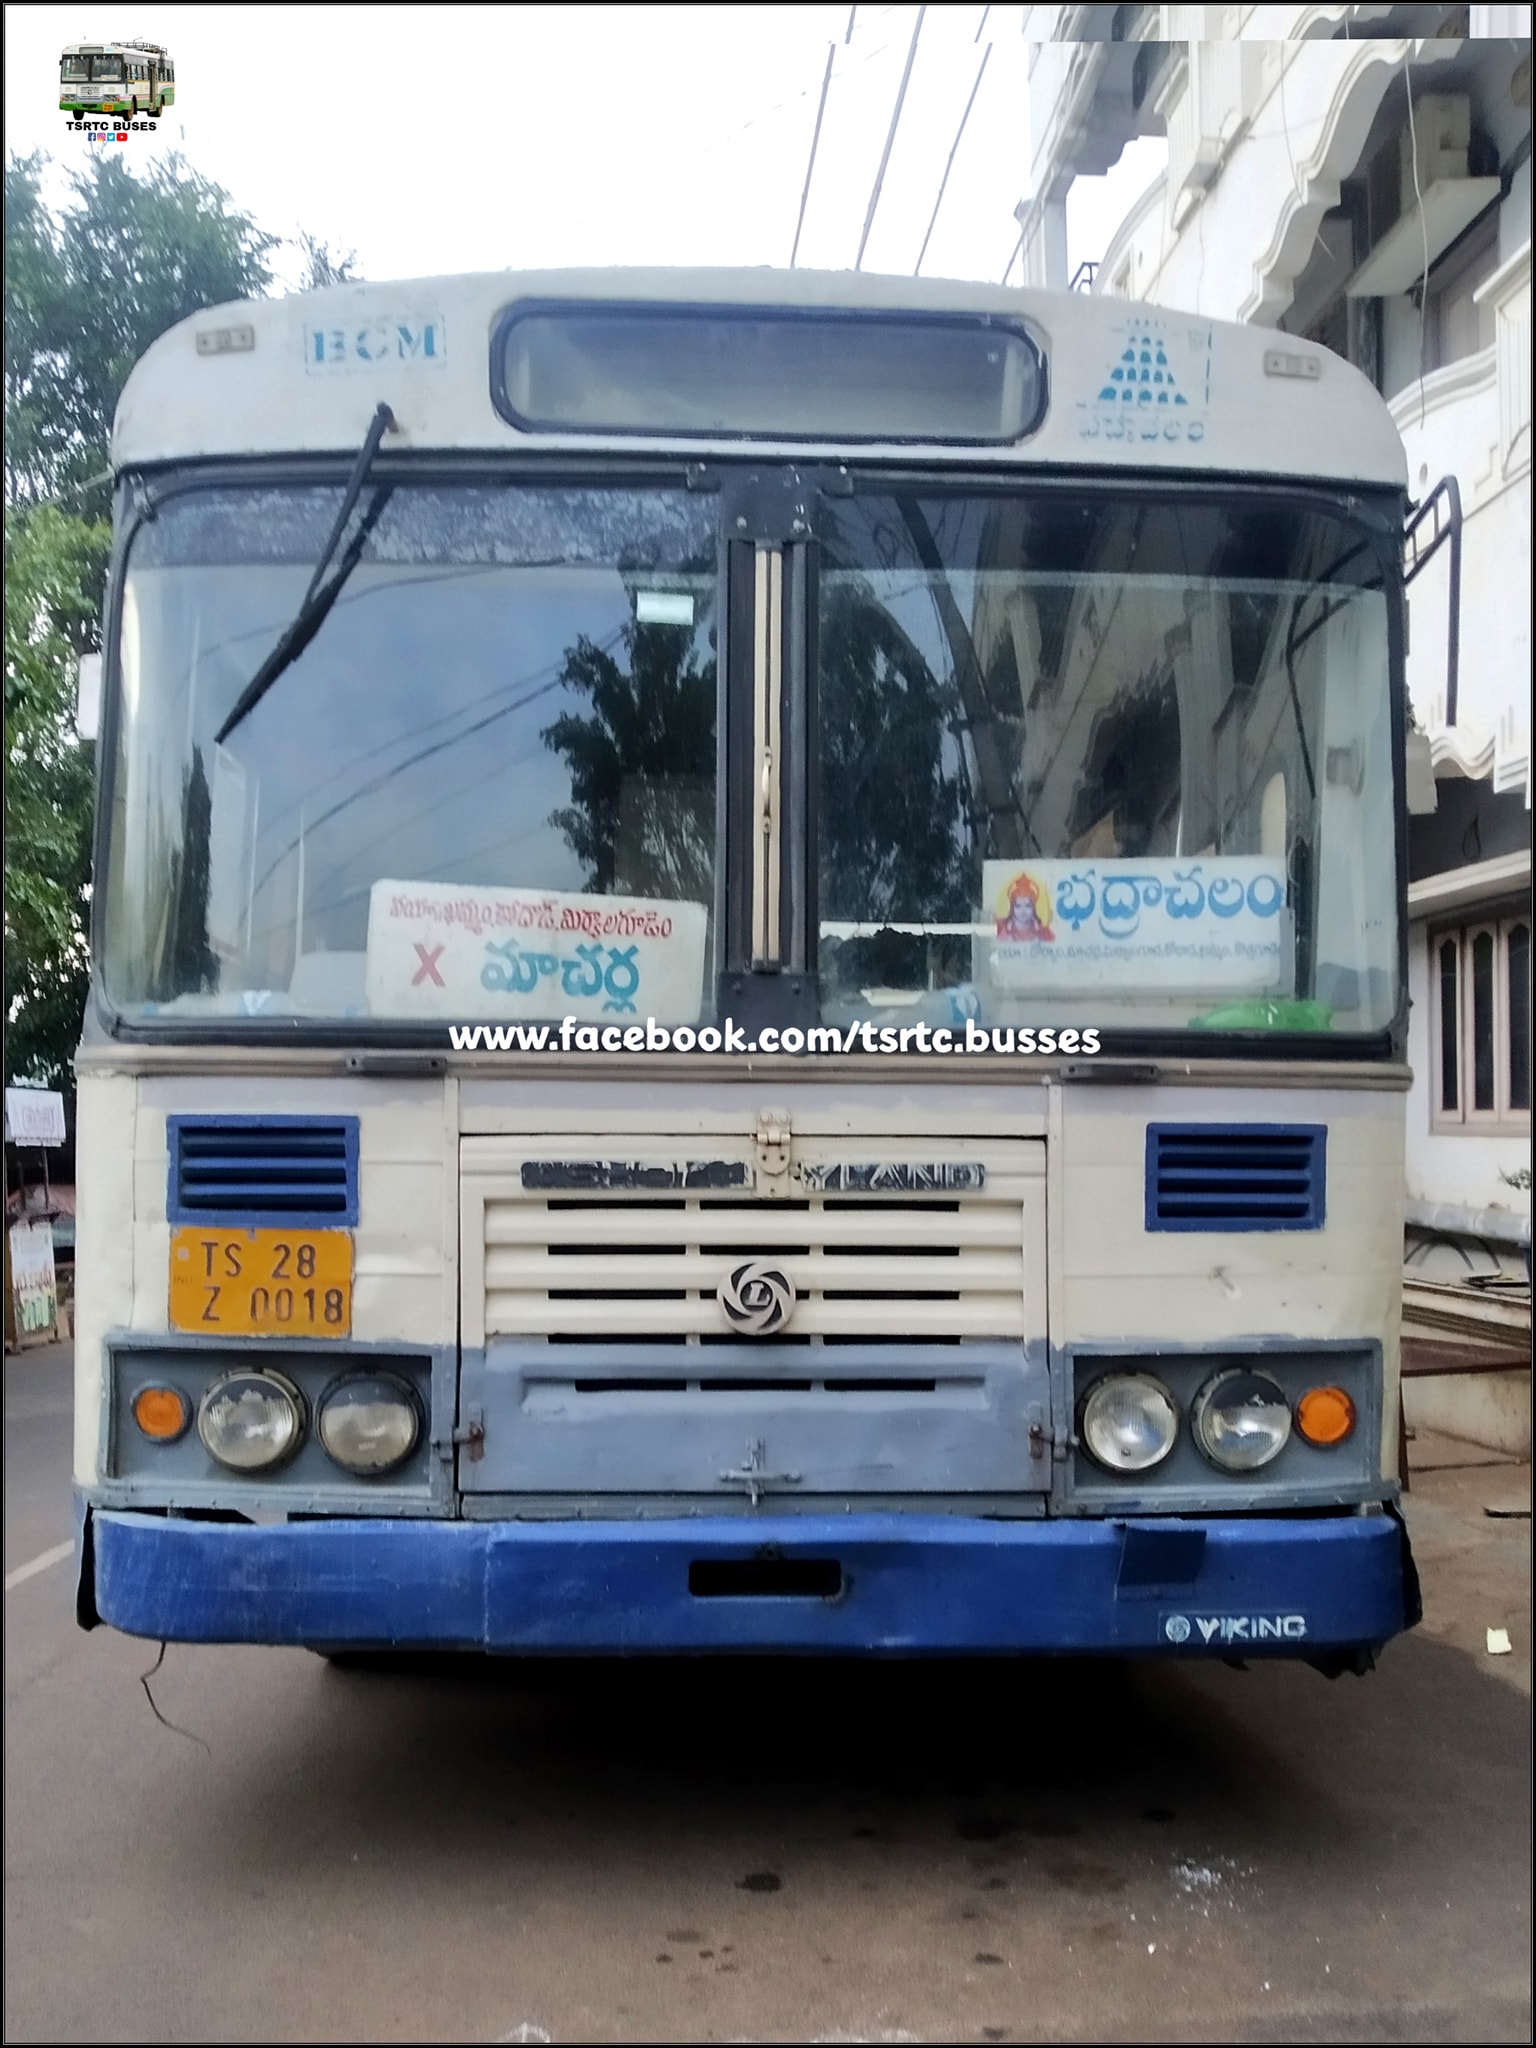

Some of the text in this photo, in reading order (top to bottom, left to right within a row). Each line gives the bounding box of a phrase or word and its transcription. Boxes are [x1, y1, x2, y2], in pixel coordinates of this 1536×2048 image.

[1055, 866, 1284, 940] భద్రాచలం
[201, 1241, 317, 1280] TS 28
[202, 1286, 344, 1324] Z 0018
[1195, 1615, 1307, 1642] VIKING
